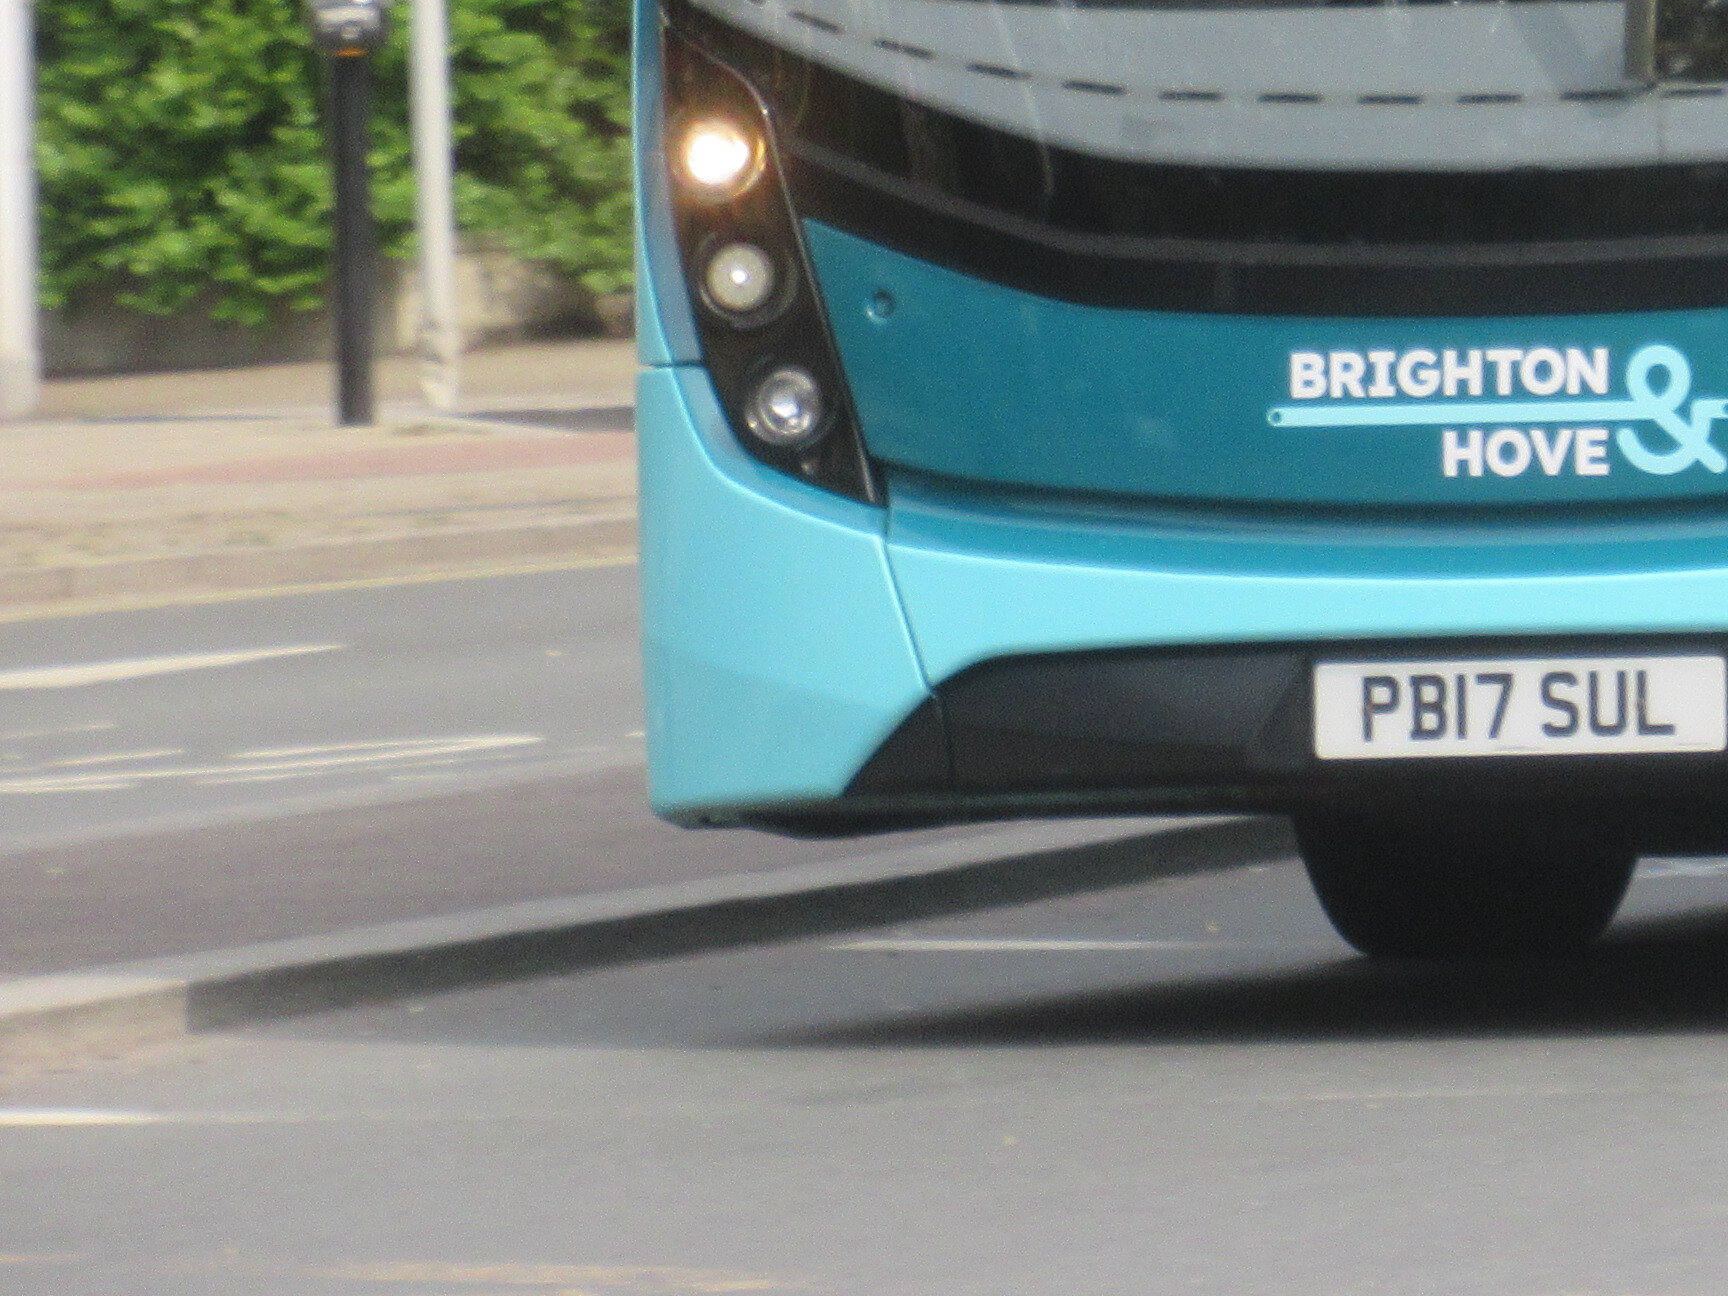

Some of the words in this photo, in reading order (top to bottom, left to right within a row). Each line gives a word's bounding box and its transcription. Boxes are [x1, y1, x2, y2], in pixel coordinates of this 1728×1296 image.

[1290, 347, 1609, 399] BRIGHTON
[1442, 429, 1609, 476] HOVE
[1362, 672, 1514, 742] PB17
[1540, 670, 1675, 739] SUL
